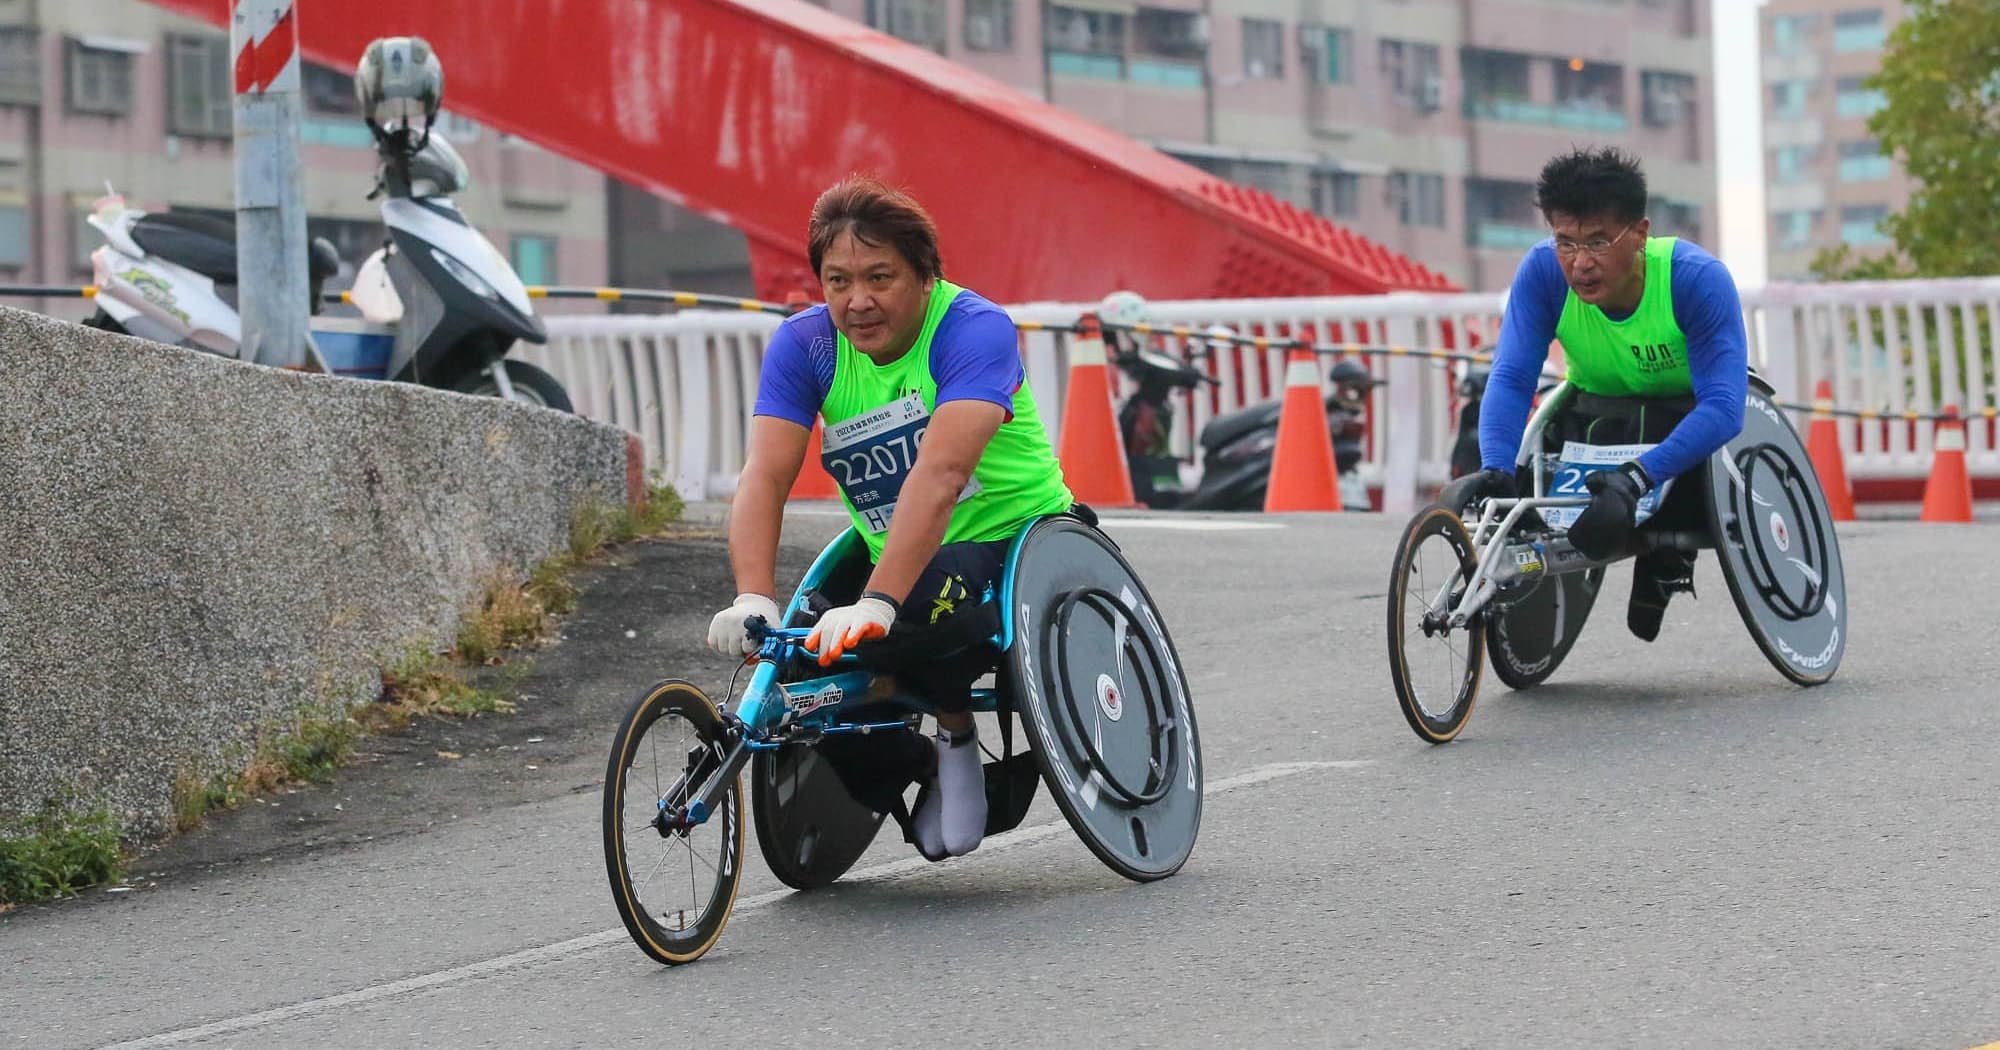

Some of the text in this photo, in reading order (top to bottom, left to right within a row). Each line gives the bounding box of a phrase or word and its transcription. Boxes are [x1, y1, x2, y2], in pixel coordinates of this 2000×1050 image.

[1745, 394, 1779, 424] IMA
[865, 509, 887, 531] H
[1021, 603, 1077, 793] CORIMA
[1141, 604, 1196, 792] CORIMA
